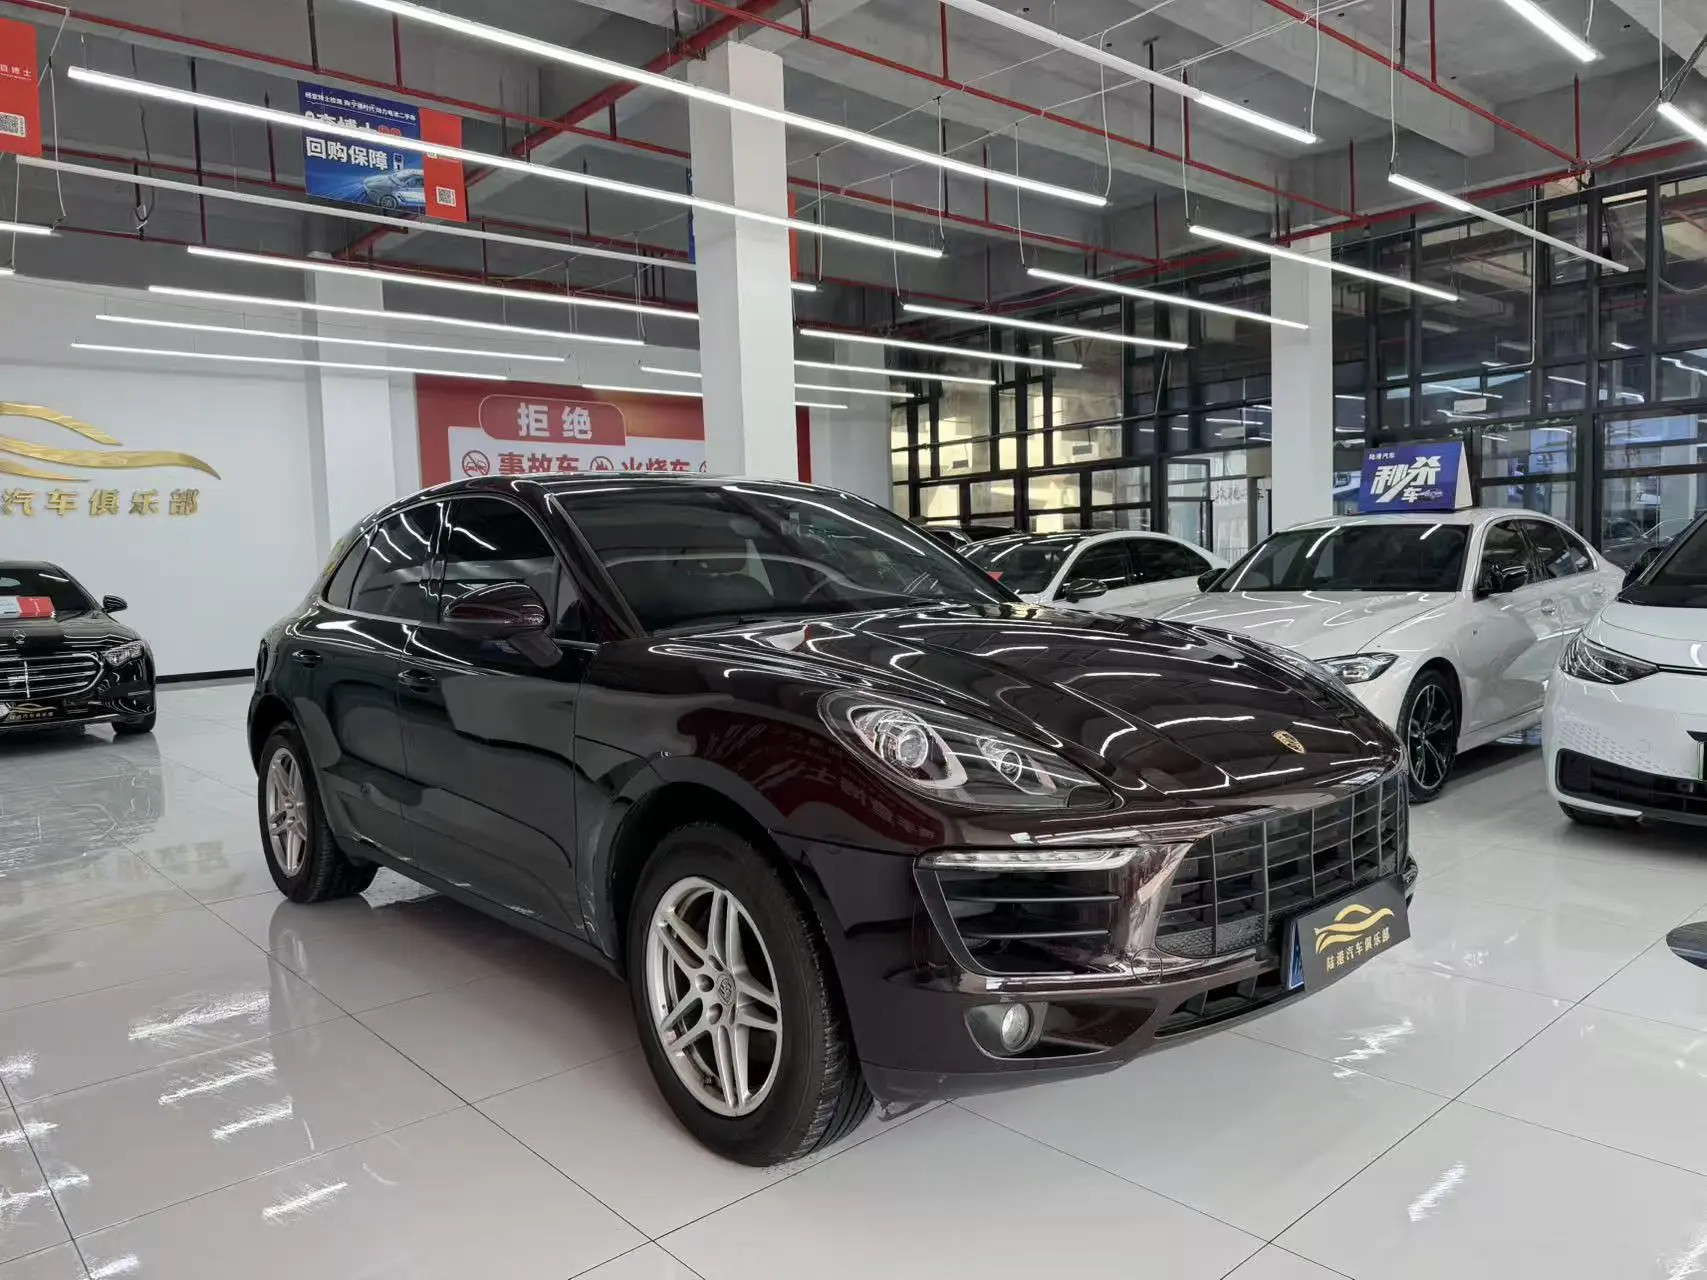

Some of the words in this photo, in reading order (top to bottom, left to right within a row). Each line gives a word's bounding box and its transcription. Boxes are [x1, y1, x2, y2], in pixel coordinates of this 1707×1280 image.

[305, 136, 388, 171] 回购保障
[517, 401, 593, 440] 拒绝
[498, 452, 580, 474] 事故车
[1370, 455, 1442, 503] 秒杀
[1, 487, 201, 517] 汽车俱乐部
[1401, 487, 1422, 503] 车
